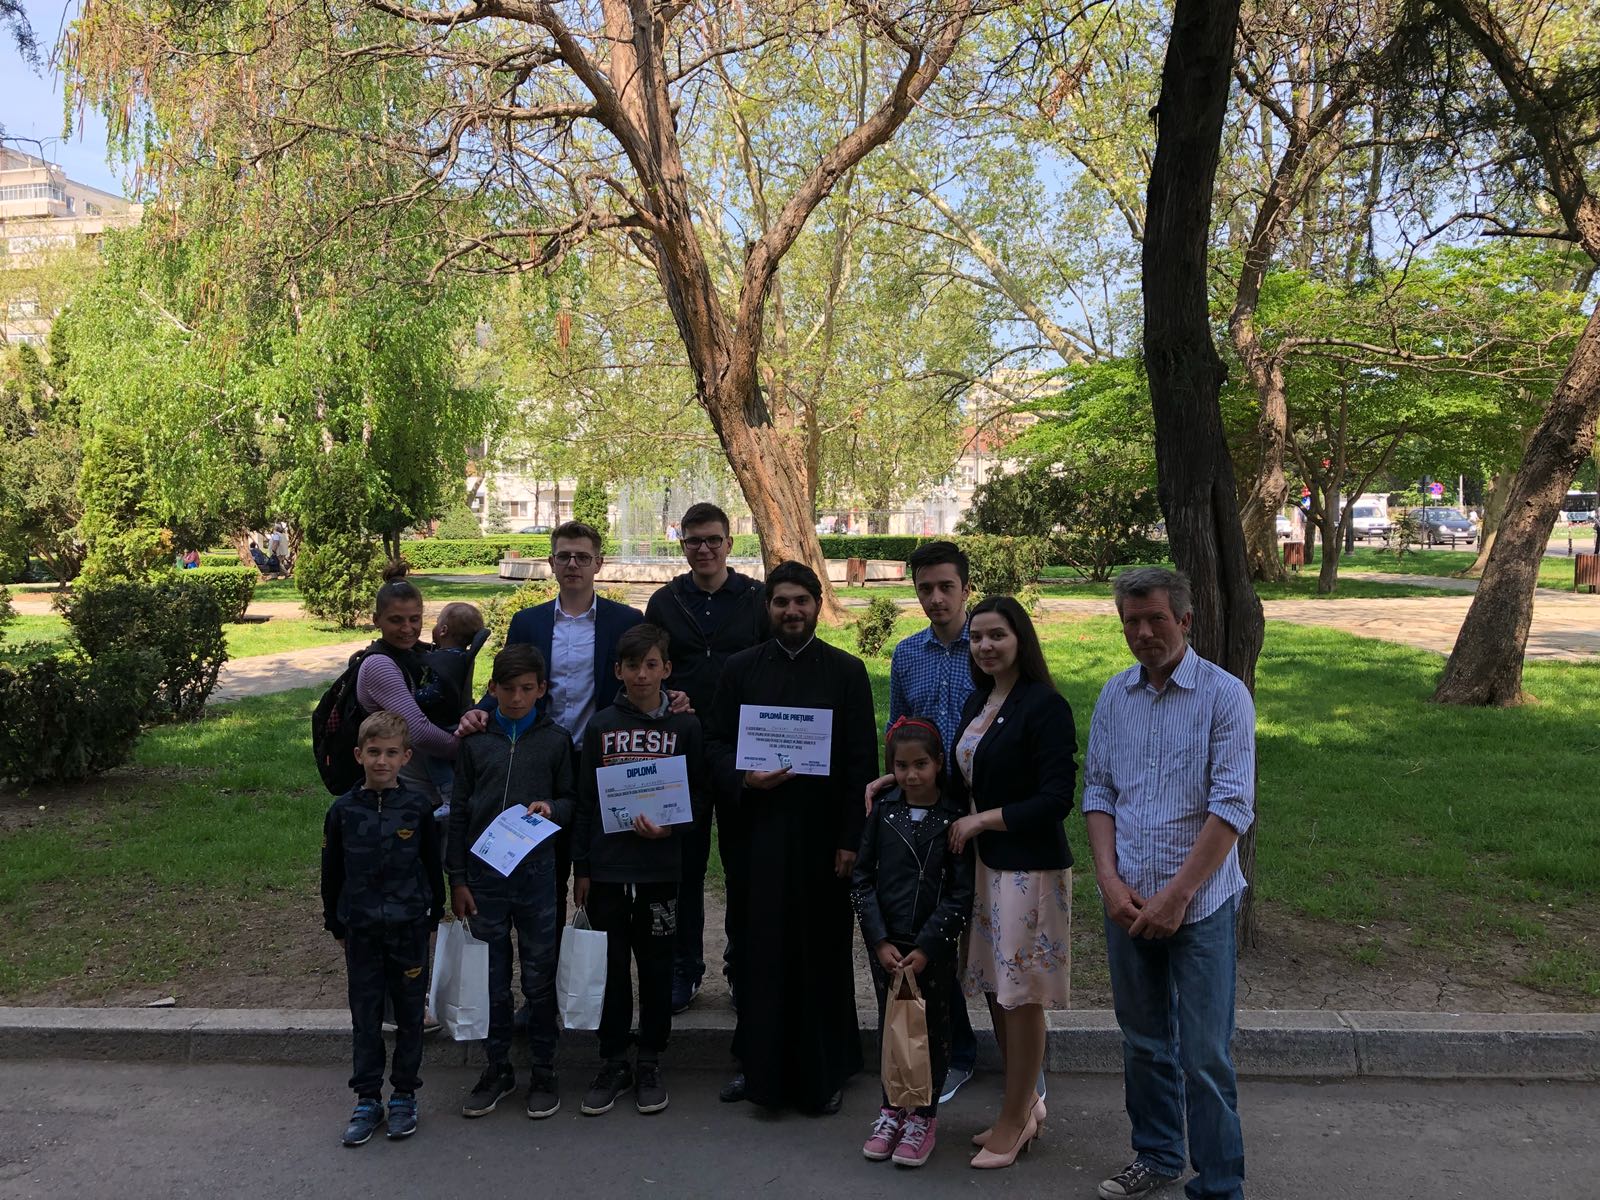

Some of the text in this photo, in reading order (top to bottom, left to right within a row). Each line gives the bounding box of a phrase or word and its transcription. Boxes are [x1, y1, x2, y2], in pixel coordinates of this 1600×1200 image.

[759, 712, 782, 720] DIPLOMĂ
[782, 713, 790, 721] DE
[602, 729, 677, 754] FRESH
[627, 763, 657, 778] DIPLOMĂ
